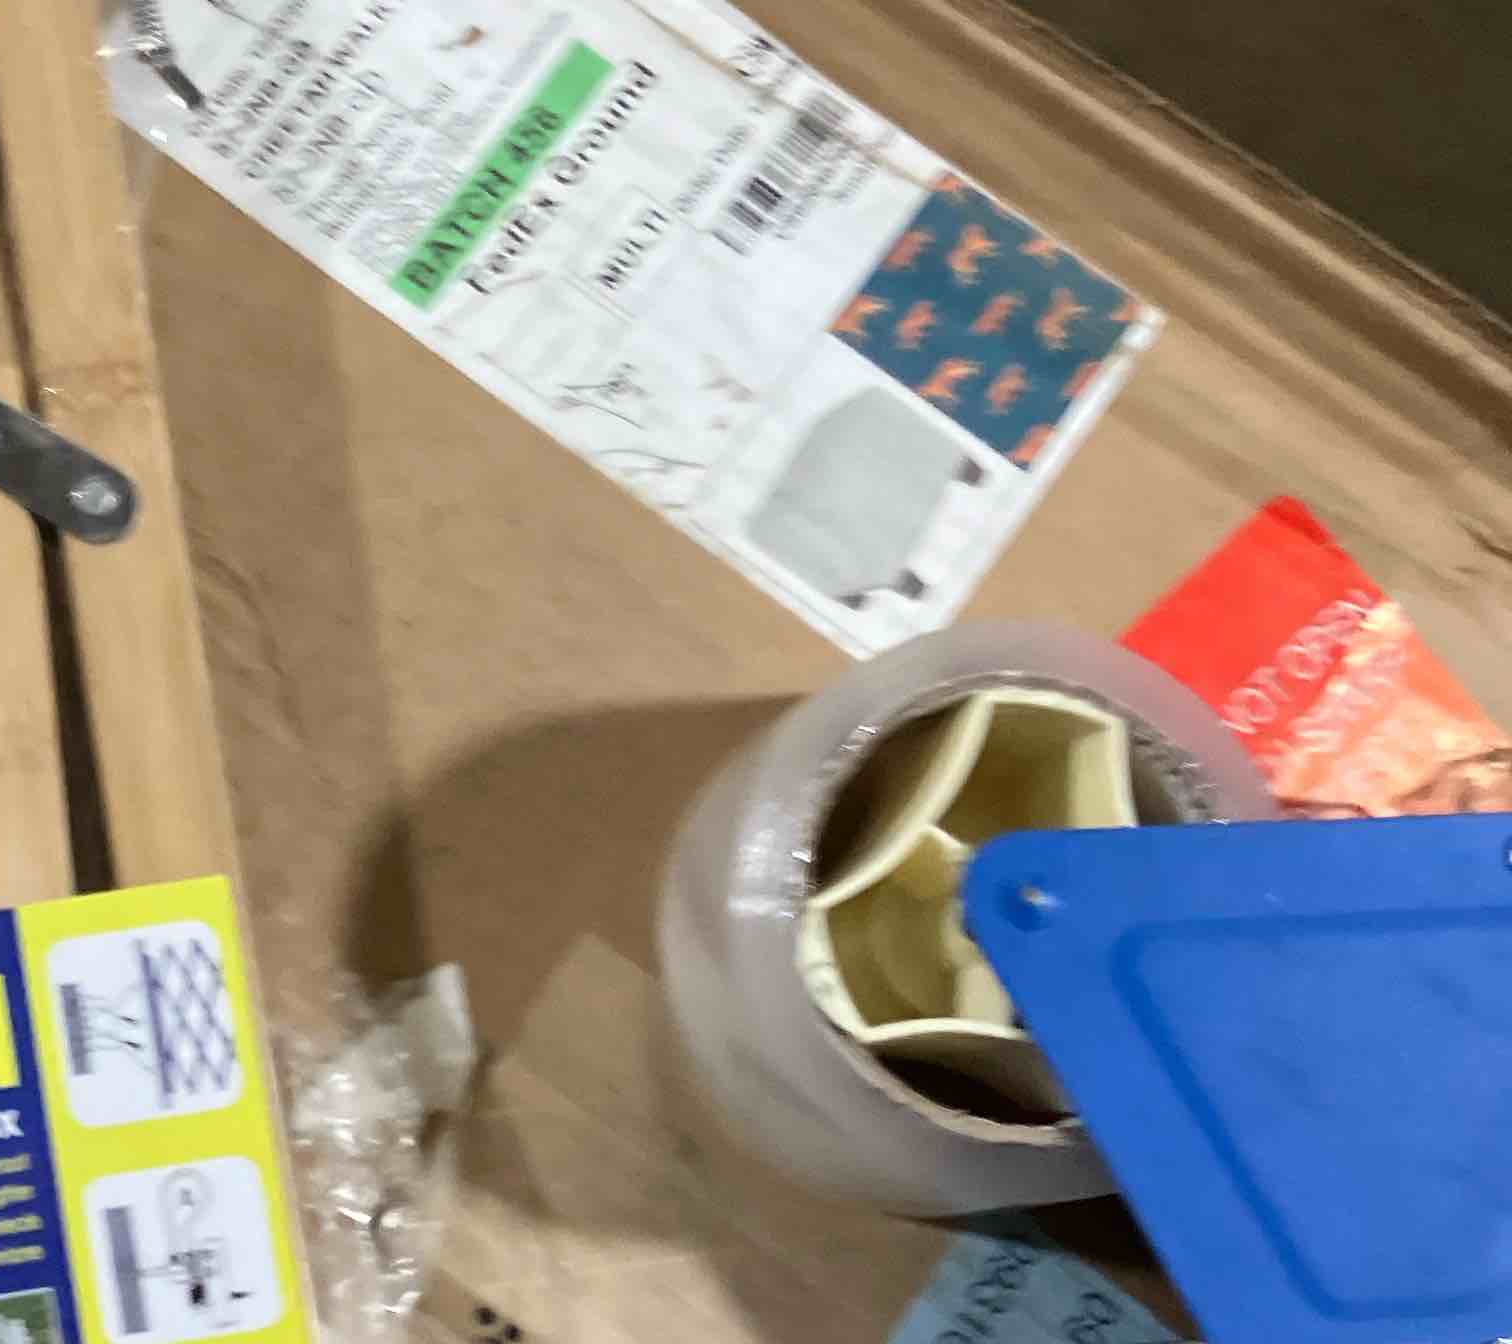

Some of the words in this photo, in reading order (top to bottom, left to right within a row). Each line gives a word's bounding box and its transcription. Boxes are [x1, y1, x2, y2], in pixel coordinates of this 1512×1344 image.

[402, 160, 517, 297] BATCH
[463, 183, 562, 300] FedEx
[544, 54, 659, 191] Ground
[595, 203, 673, 294] MULTI
